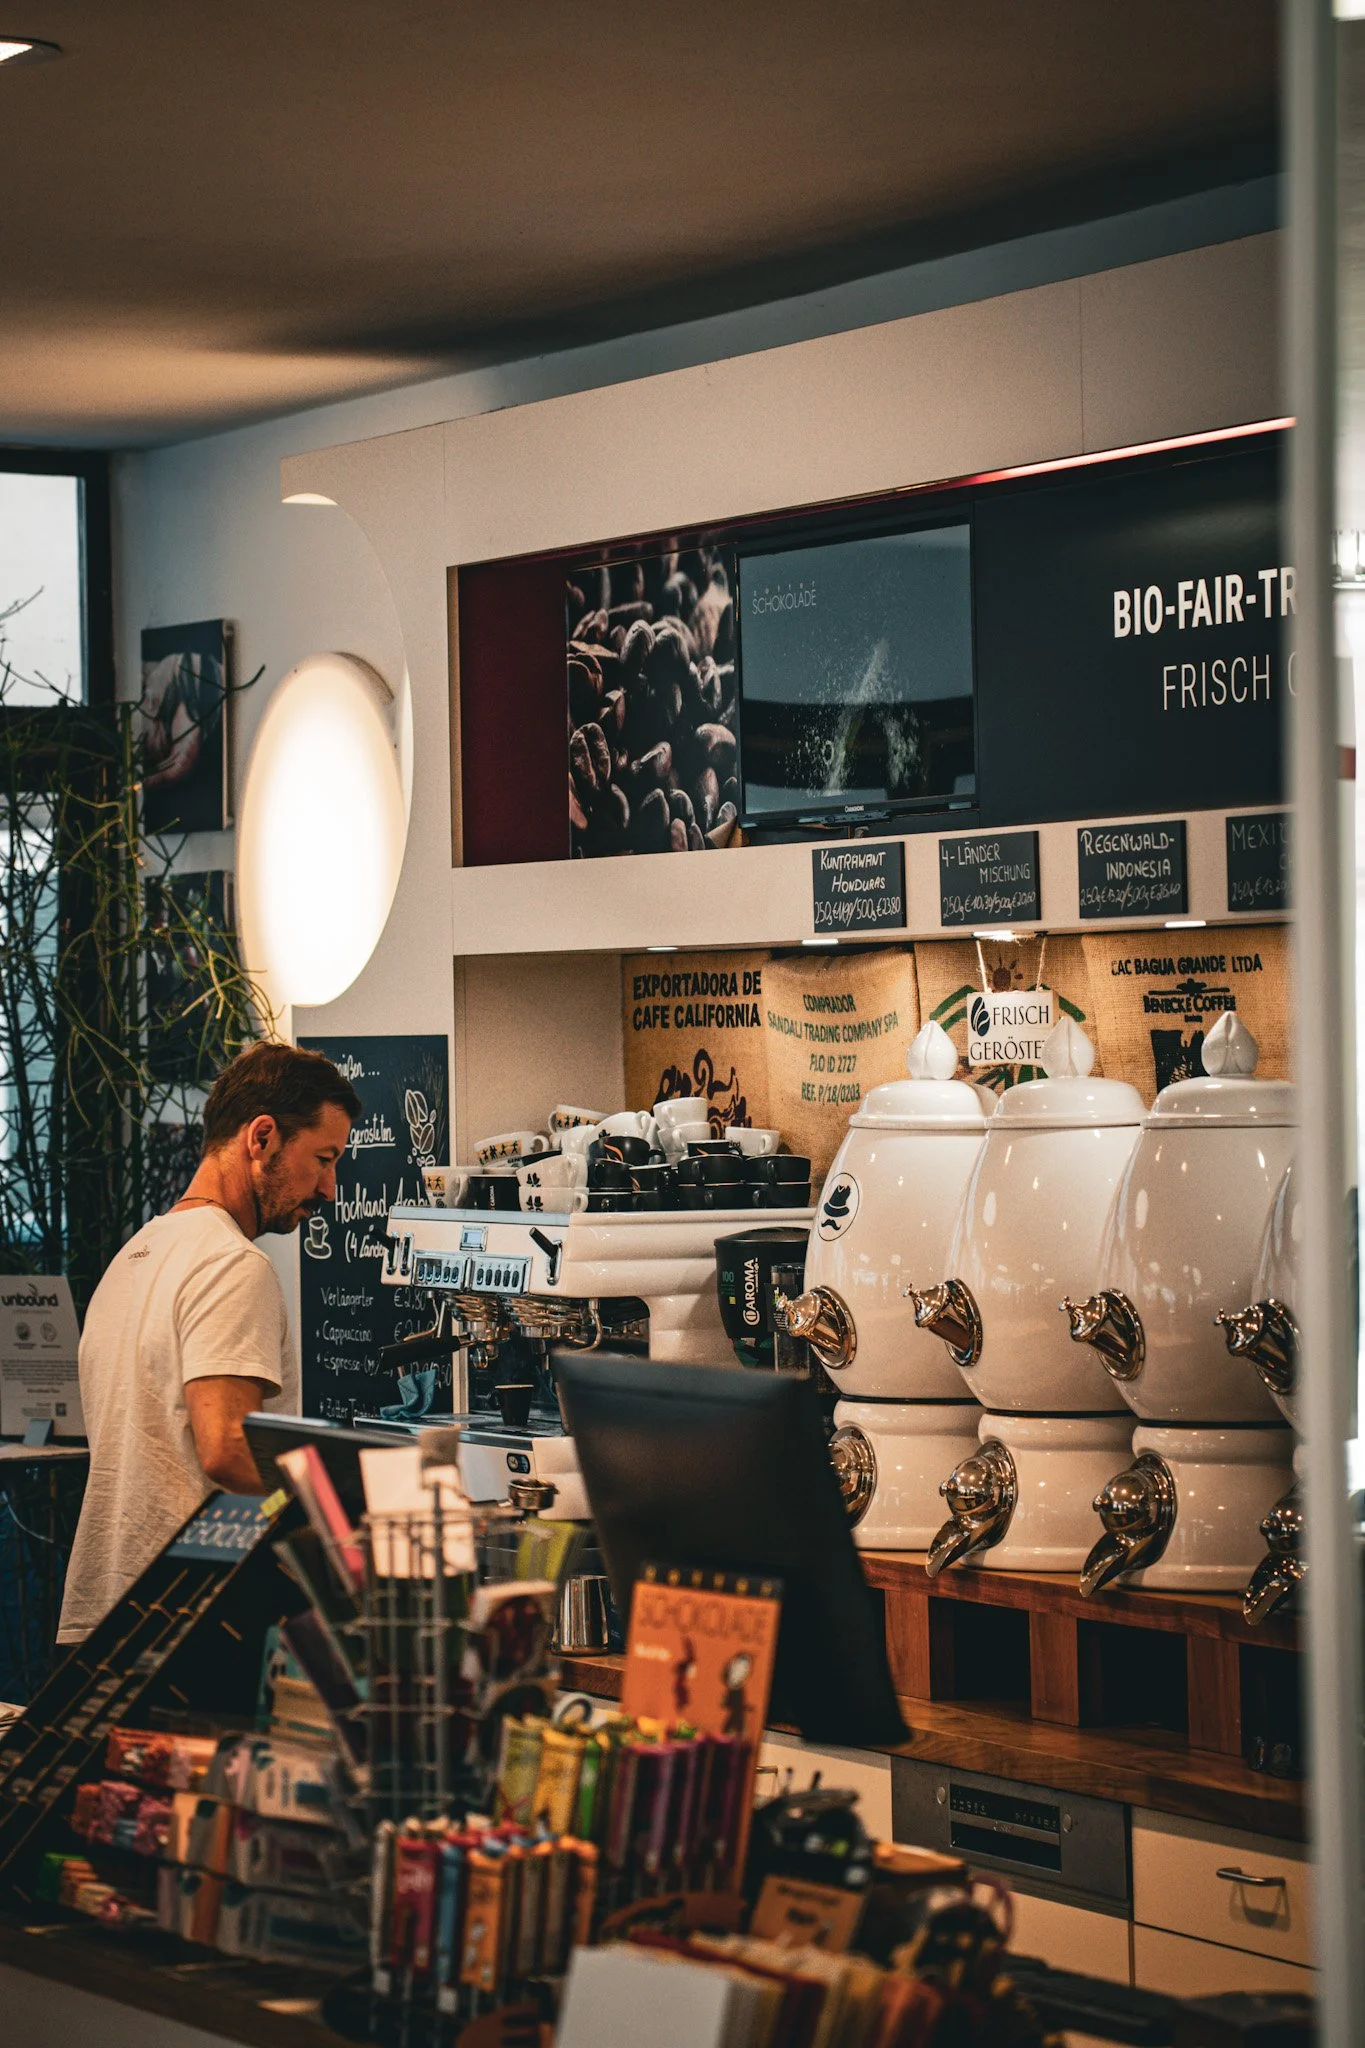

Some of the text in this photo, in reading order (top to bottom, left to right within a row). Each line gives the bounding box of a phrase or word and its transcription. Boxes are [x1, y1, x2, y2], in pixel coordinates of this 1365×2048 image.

[752, 589, 817, 615] SCHOKOLADE
[1113, 566, 1299, 638] BIO-FAIR-TR
[1163, 654, 1270, 710] FRISCH
[1081, 830, 1175, 856] REGENWALD-
[821, 850, 886, 871] KUNTRAWANT
[1106, 858, 1171, 880] INDONESIA
[831, 873, 886, 893] HONDURAS
[980, 863, 1030, 884] MISCHUNG
[1134, 957, 1176, 976] BAGUA
[1178, 955, 1227, 975] GRANDE
[1232, 953, 1263, 973] LTDA
[633, 971, 762, 1000] EXPORTADORA DE
[803, 993, 856, 1013] COMPRADOR
[993, 1005, 1049, 1025] FRISCH
[633, 1003, 761, 1031] CAFE CALIFORNIA
[804, 1022, 840, 1042] TRADING
[842, 1017, 882, 1042] COMPANY
[884, 1010, 898, 1033] SPA
[970, 1036, 1045, 1061] GERÖSTE
[827, 1055, 836, 1072] ID
[837, 1055, 857, 1073] 2727
[335, 1182, 388, 1224] Hochland
[1, 1292, 59, 1307] unbound
[321, 1287, 374, 1315] Verlängerter
[322, 1320, 372, 1346] Cappuccino
